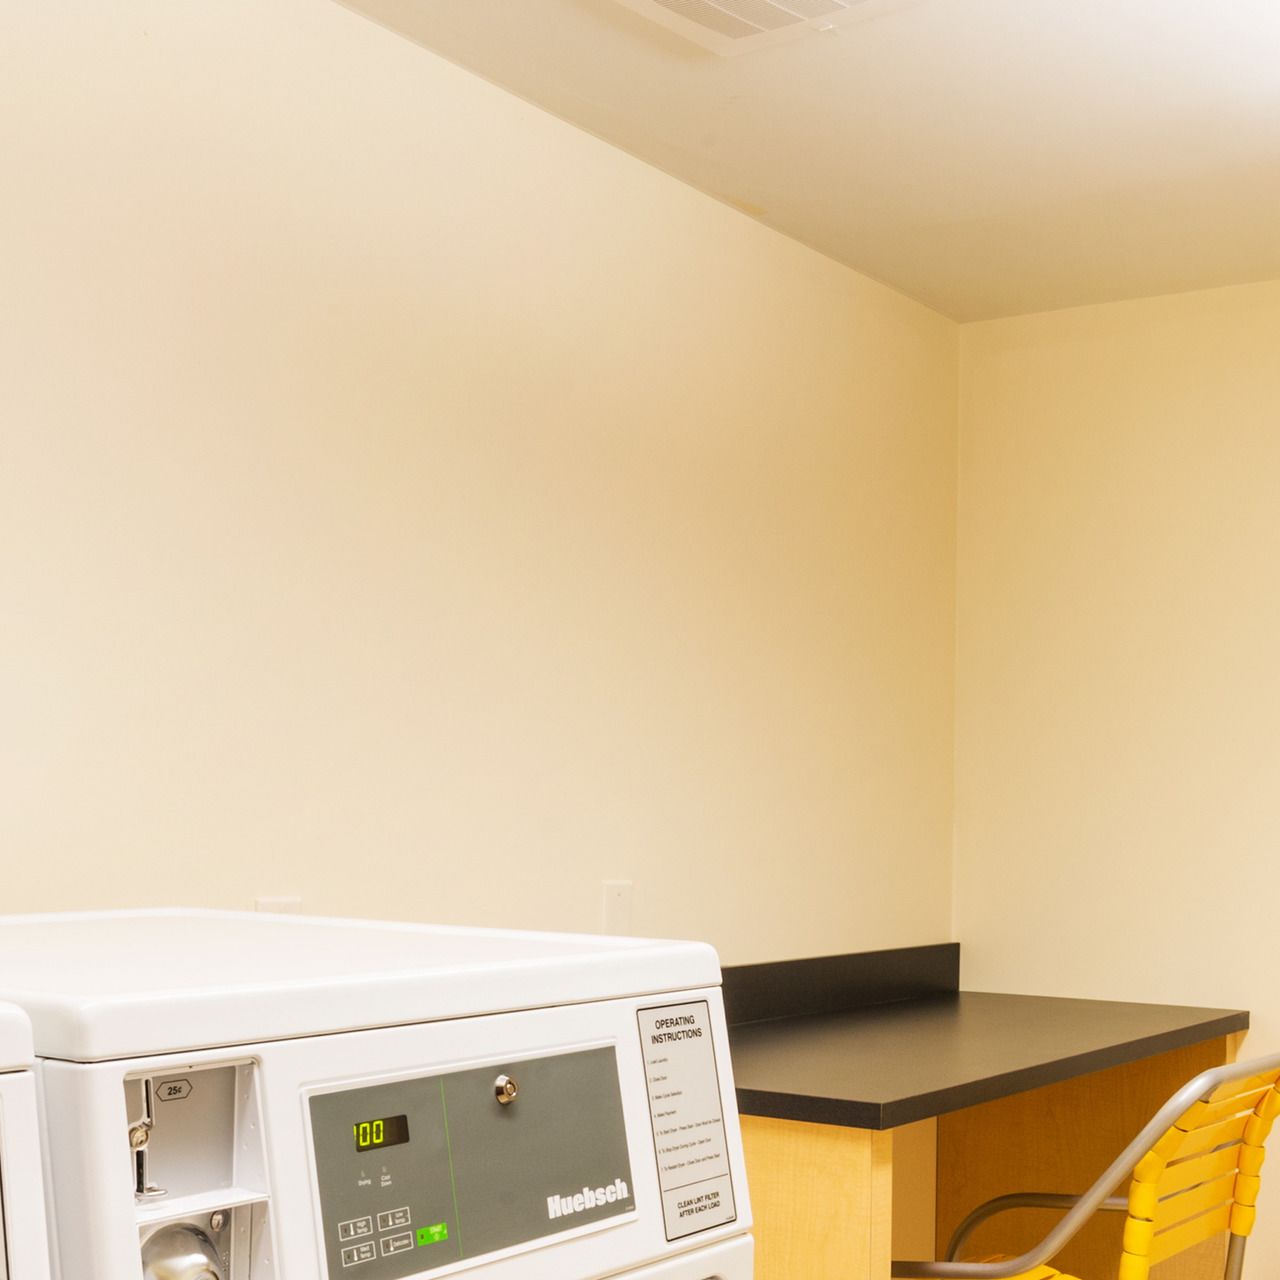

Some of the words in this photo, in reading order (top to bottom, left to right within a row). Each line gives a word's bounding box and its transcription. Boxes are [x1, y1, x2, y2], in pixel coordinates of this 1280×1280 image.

[655, 1015, 695, 1029] OPERATING
[651, 1028, 702, 1044] INSTRUCTIONS
[547, 1178, 628, 1219] Huebsch
[677, 1200, 693, 1208] CLEAN
[680, 1208, 694, 1217] AFTER
[708, 1201, 720, 1209] LOAD
